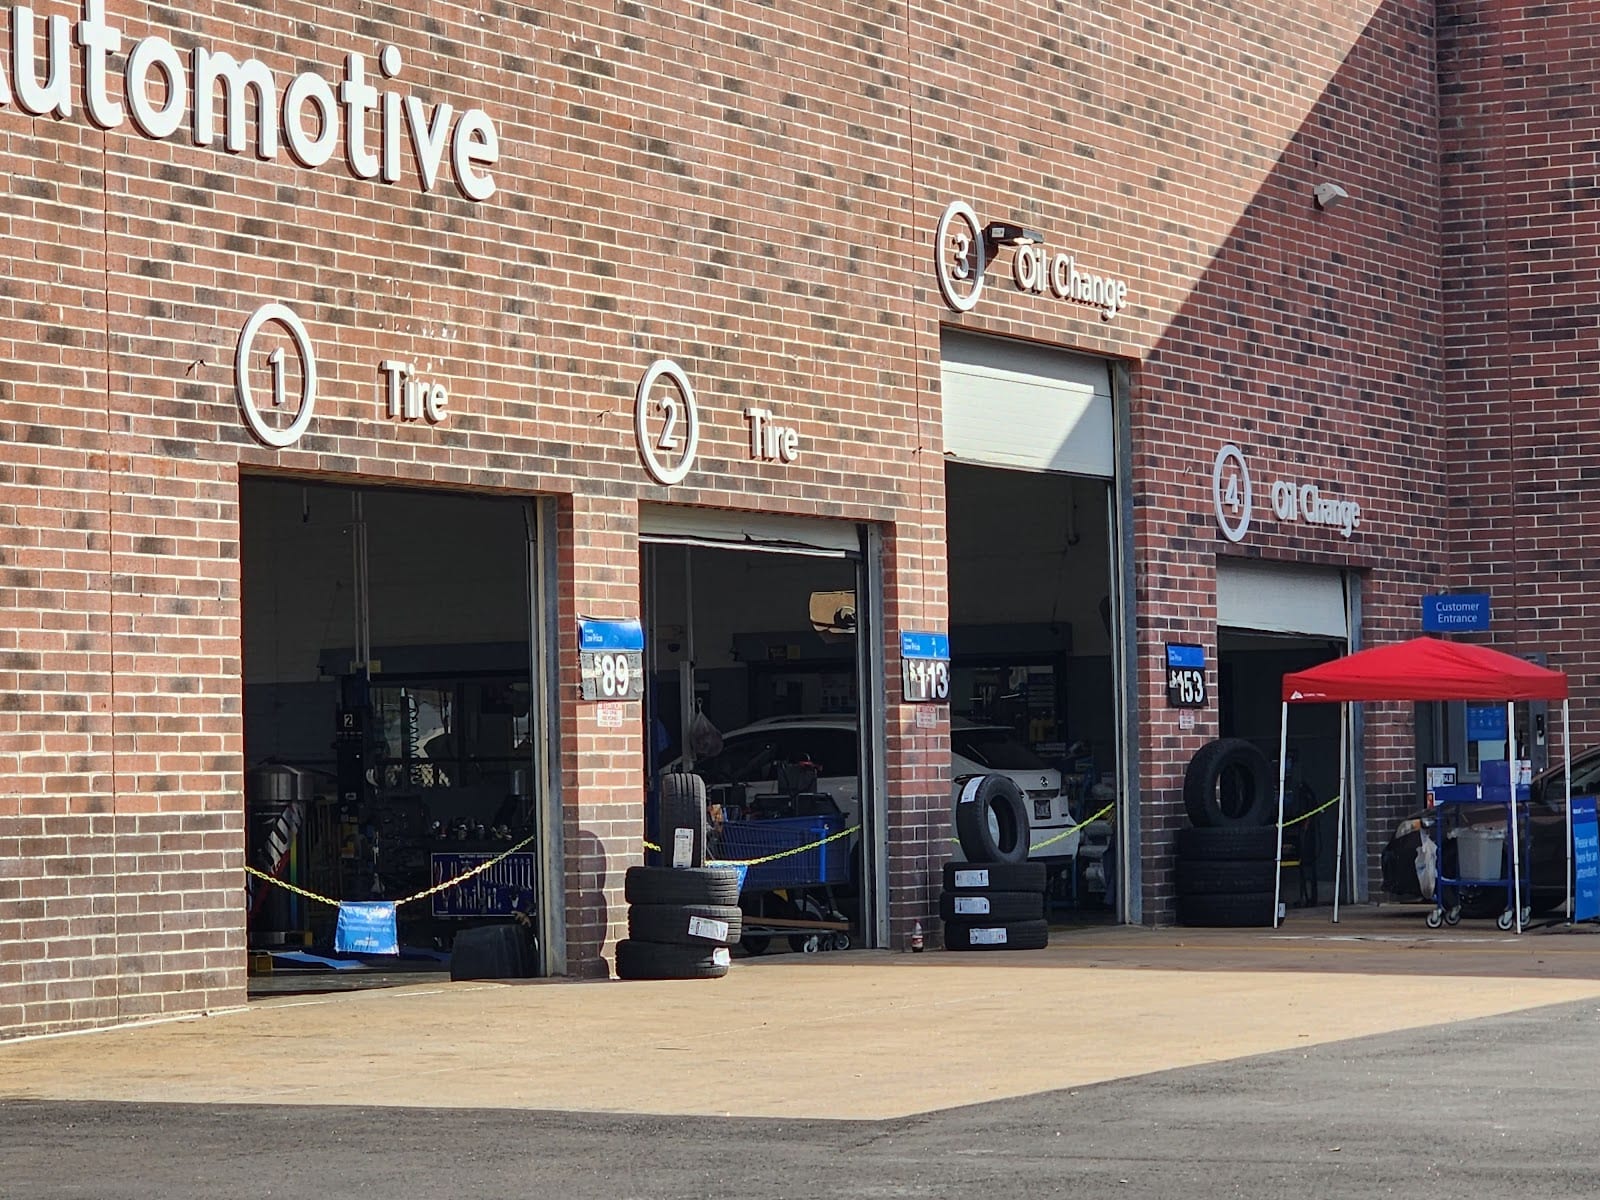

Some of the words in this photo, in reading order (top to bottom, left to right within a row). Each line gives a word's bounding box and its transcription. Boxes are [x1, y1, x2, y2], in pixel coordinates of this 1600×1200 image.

[0, 0, 500, 201] utomotive
[953, 233, 970, 279] 3
[1014, 245, 1047, 293] Oil
[1050, 253, 1128, 320] Change
[270, 347, 286, 405] 1
[379, 359, 449, 423] Tire
[656, 396, 679, 449] 2
[744, 407, 799, 463] Tire
[1225, 474, 1240, 513] 4
[1271, 480, 1298, 520] Oil
[1300, 484, 1361, 538] Change
[1435, 601, 1480, 612] Customer
[1437, 613, 1478, 623] Entrance
[594, 655, 629, 696] $89
[909, 661, 949, 699] $113
[1169, 670, 1203, 703] $153
